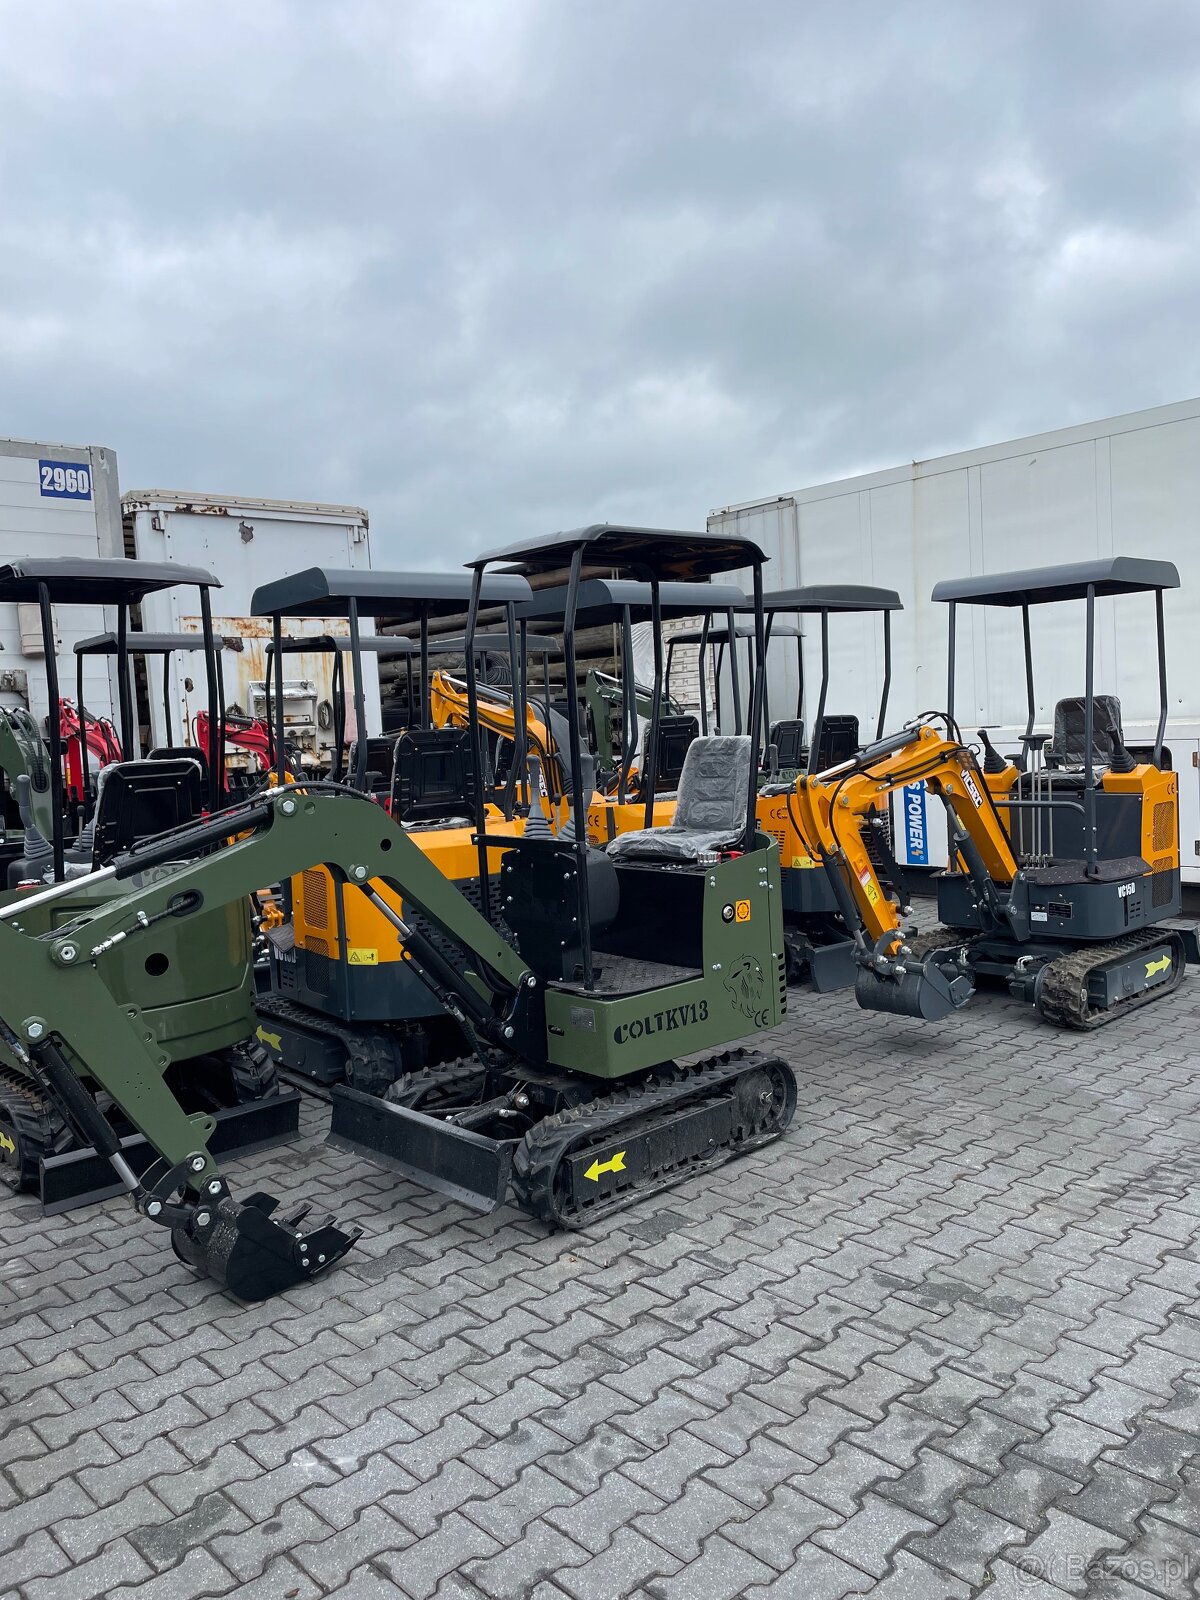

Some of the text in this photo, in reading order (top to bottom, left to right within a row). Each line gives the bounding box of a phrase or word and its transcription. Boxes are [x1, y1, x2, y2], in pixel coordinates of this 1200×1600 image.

[41, 466, 90, 494] 2960
[908, 793, 924, 849] POWER
[613, 1000, 709, 1045] COLTKV13
